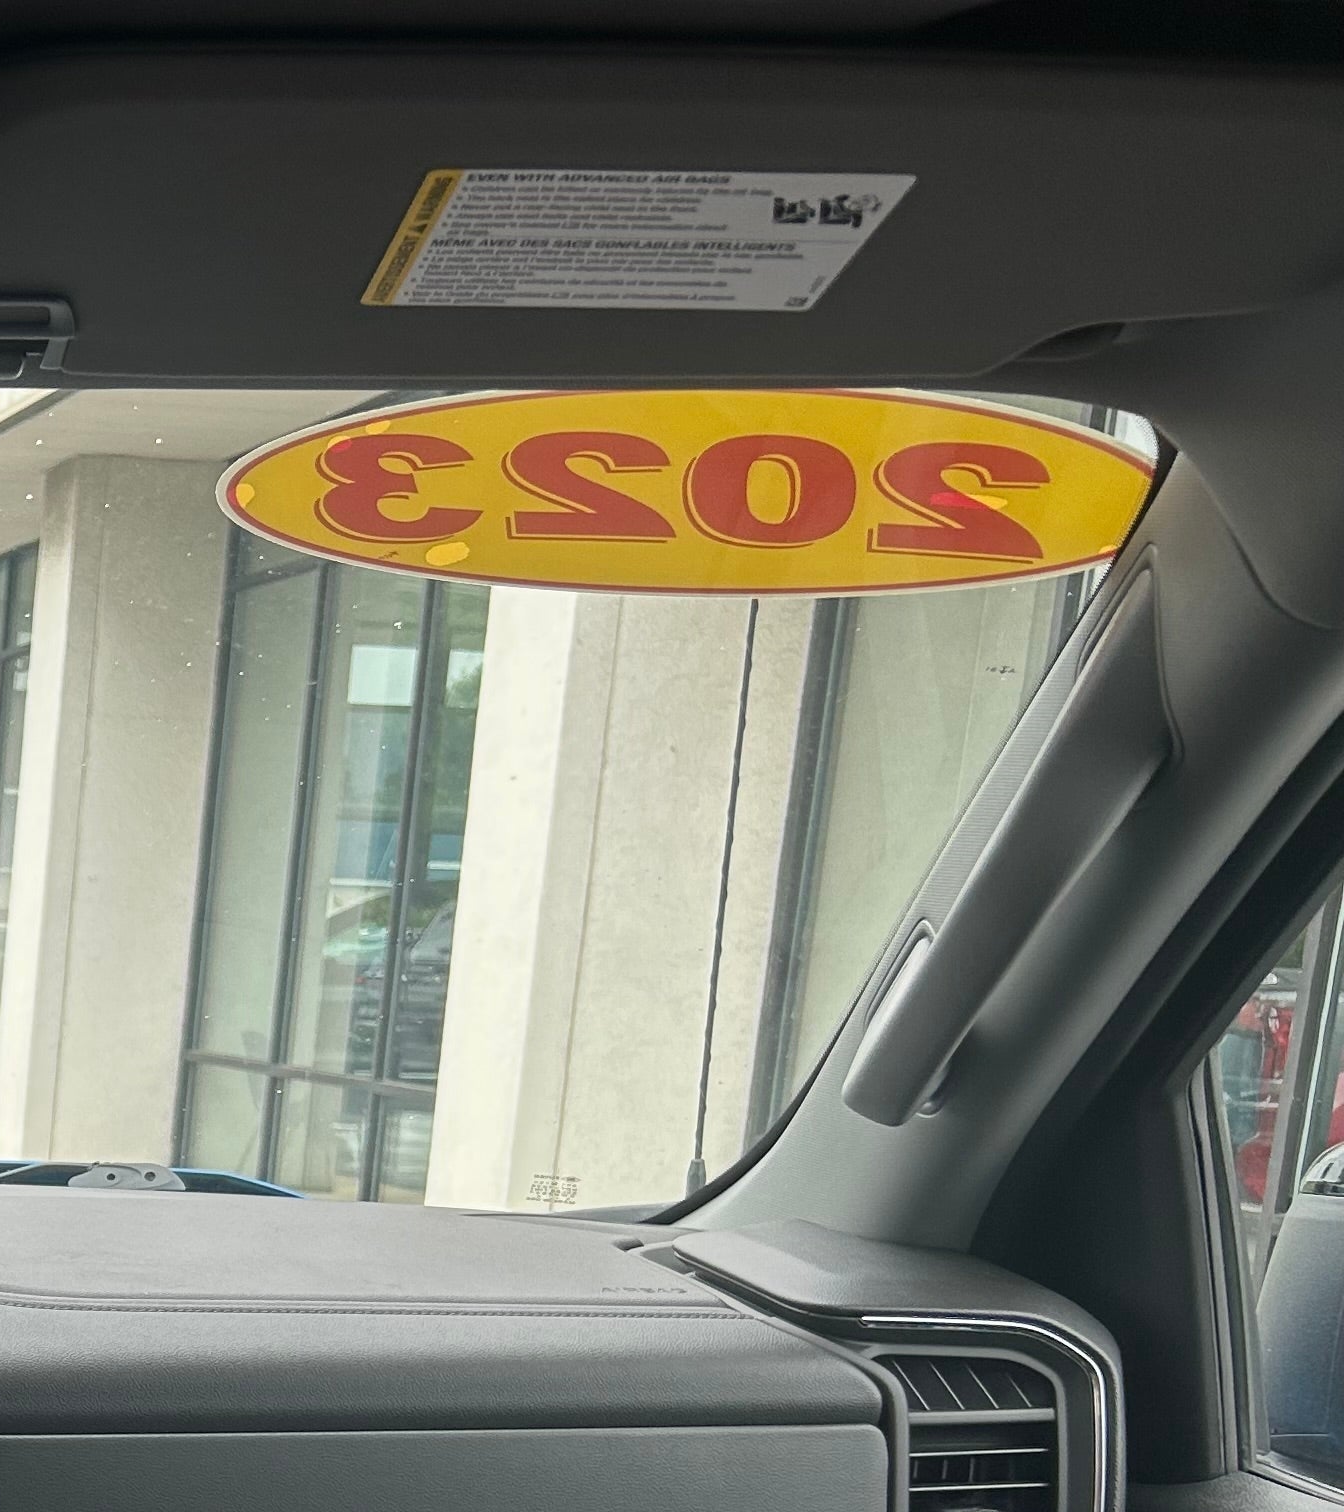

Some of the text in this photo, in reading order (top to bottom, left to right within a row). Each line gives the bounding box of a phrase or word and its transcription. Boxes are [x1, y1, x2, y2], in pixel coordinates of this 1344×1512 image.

[466, 174, 731, 184] EVEN WITH ADVANCED AIR BAGS
[693, 241, 797, 250] INTELLIGENTS
